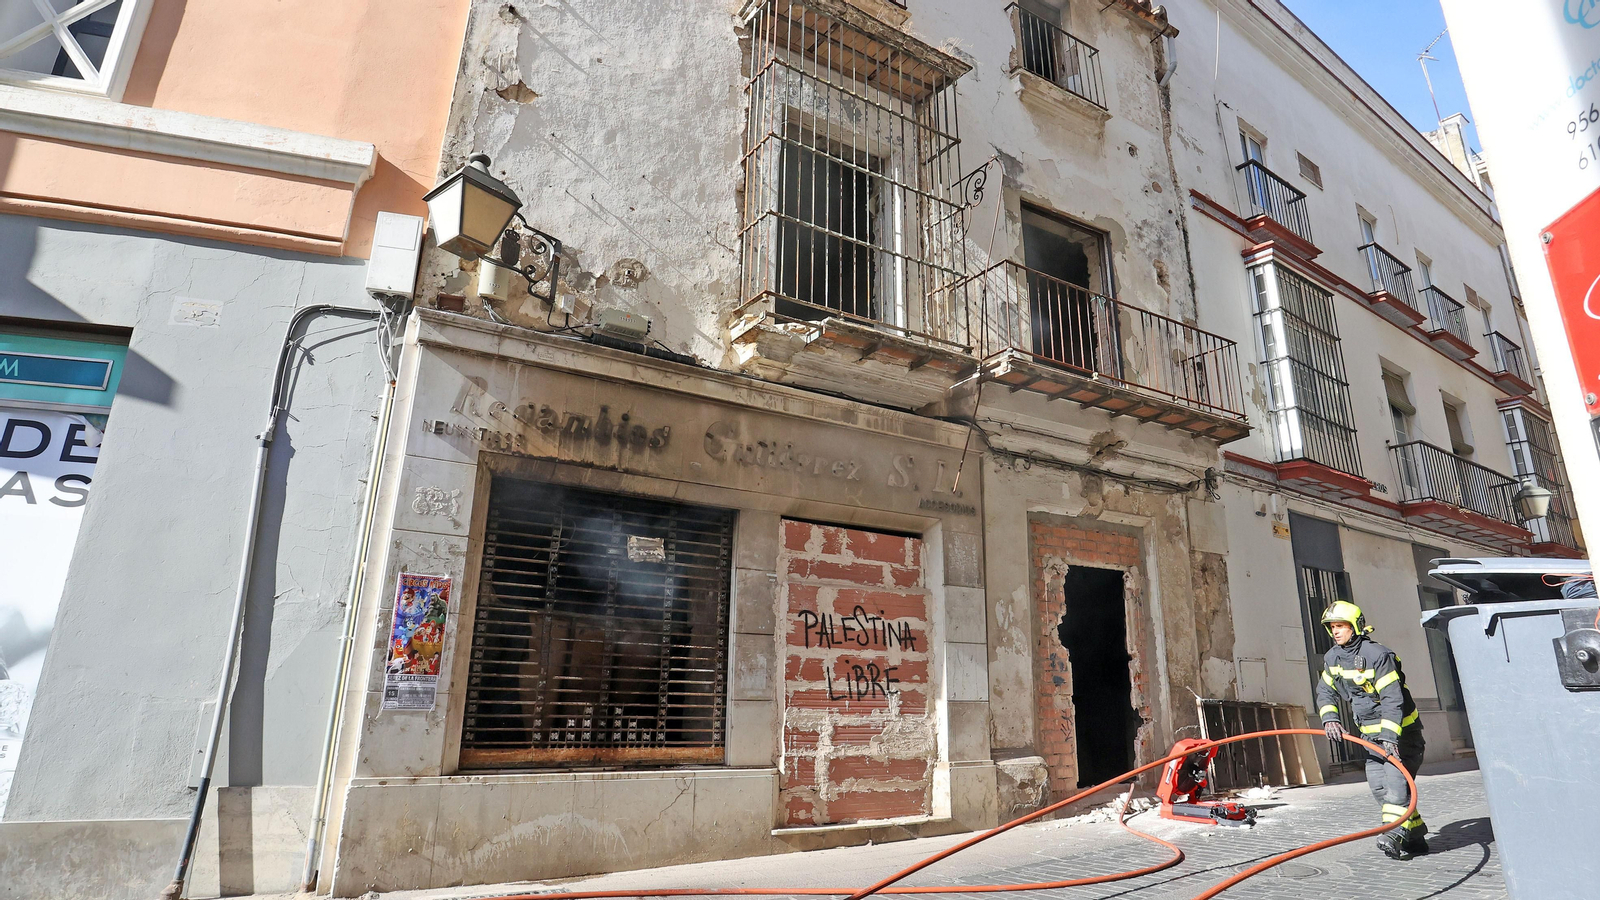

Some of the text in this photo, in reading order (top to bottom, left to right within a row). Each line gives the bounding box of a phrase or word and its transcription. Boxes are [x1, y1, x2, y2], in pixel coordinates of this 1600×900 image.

[1578, 135, 1600, 170] 61
[402, 577, 428, 588] CIRCUS
[798, 605, 917, 652] PALESTINA
[826, 659, 900, 701] LIBRE
